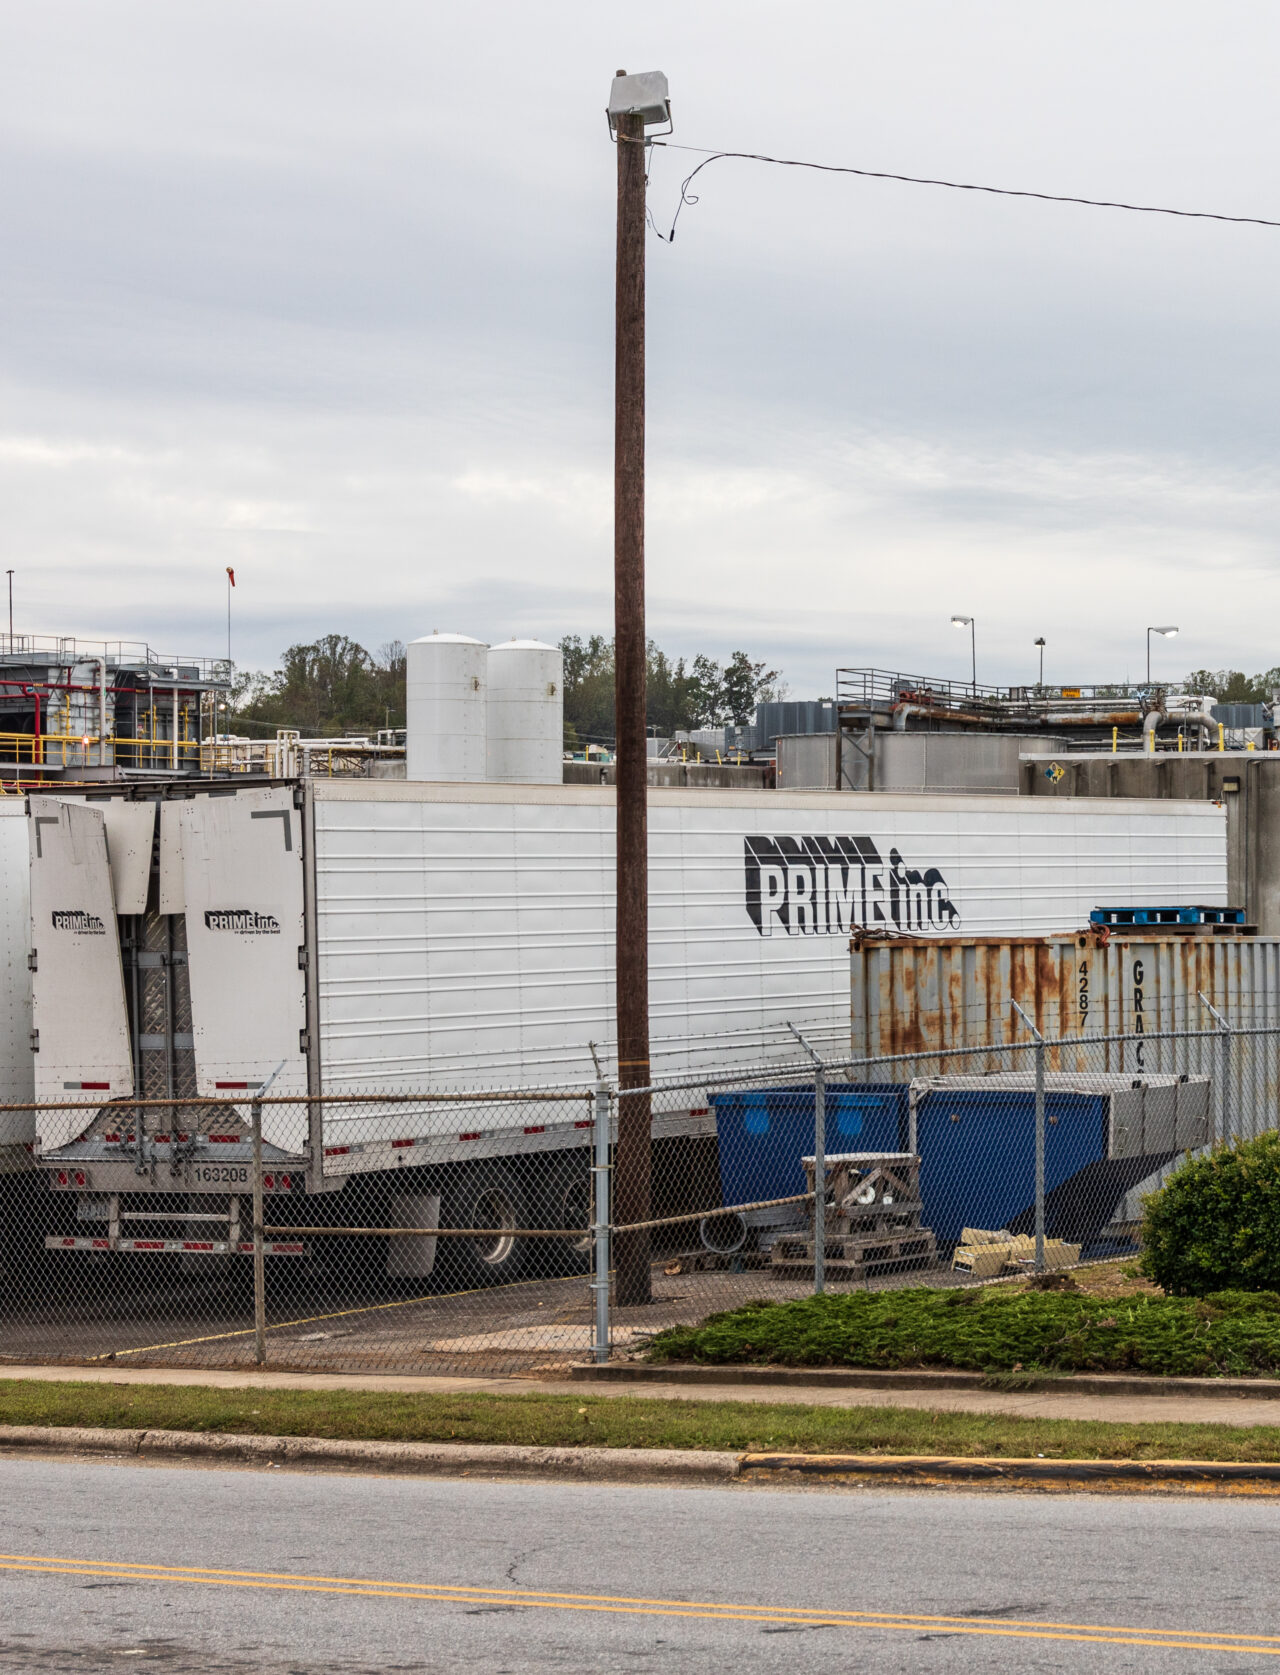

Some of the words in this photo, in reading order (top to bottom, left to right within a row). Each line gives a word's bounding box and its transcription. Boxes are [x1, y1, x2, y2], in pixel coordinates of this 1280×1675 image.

[745, 836, 887, 937] PRIME
[889, 847, 961, 932] inc.
[52, 911, 87, 930] PRIME
[204, 910, 254, 930] PRIME
[1079, 960, 1089, 1027] 4287
[1133, 960, 1144, 1074] GRAC
[195, 1167, 248, 1182] 163208
